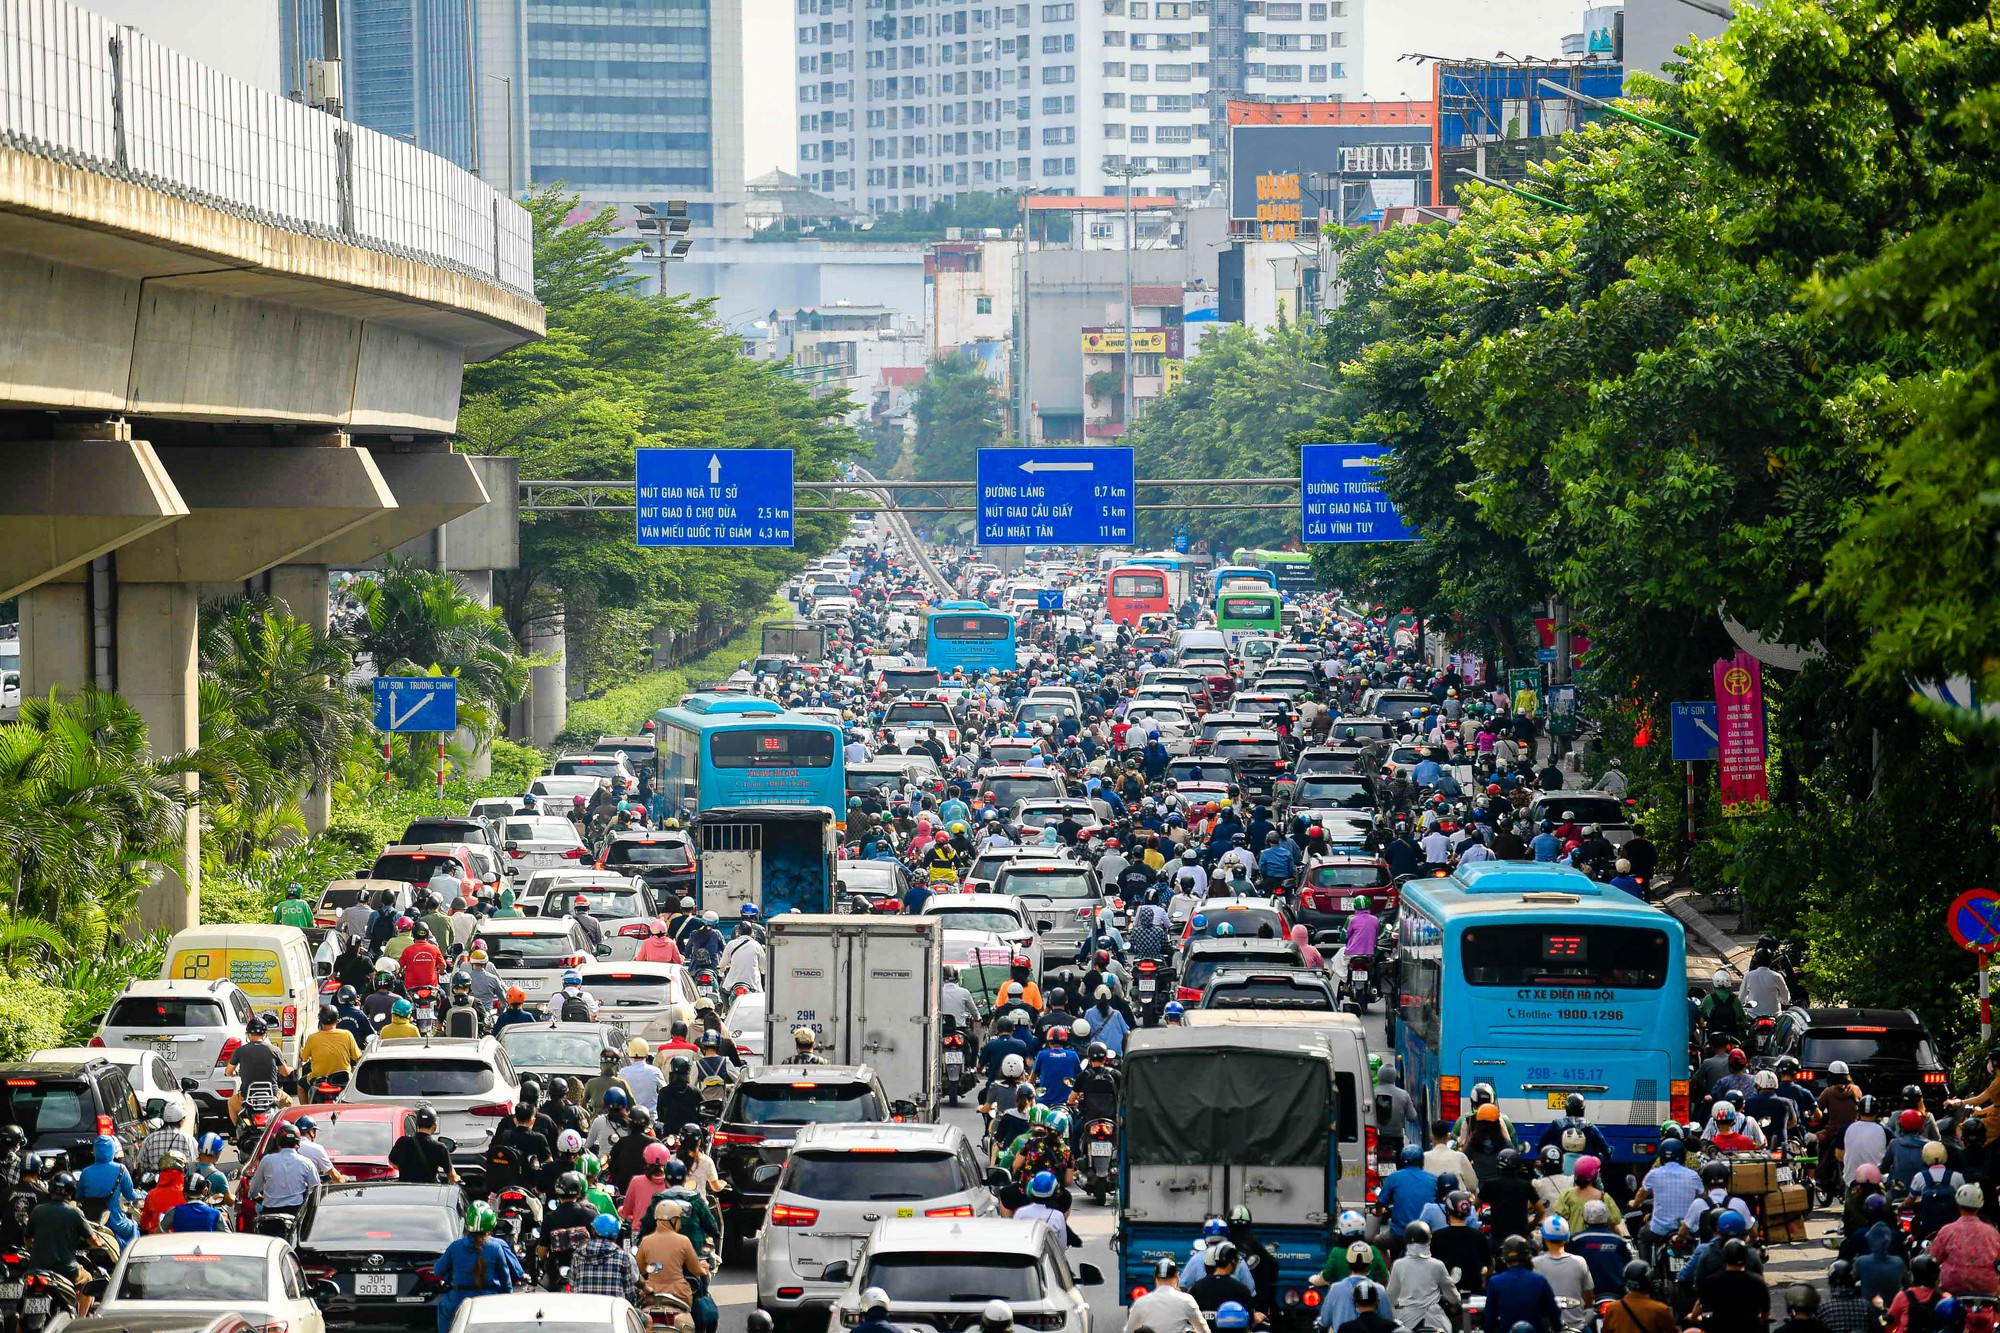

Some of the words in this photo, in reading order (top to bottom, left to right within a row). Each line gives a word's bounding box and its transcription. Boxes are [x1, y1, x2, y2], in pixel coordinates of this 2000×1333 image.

[641, 484, 658, 498] NÚT
[662, 487, 682, 498] GIAO
[686, 485, 705, 498] NGÃ
[709, 487, 721, 498] TƯ
[725, 484, 738, 498] SỞ
[985, 483, 1017, 498] ĐƯỜNG
[1021, 484, 1045, 497] LÁNG
[1111, 486, 1125, 497] km
[1307, 480, 1339, 494] ĐƯỜNG
[641, 504, 658, 518] NÚT
[662, 507, 682, 518] GIAO
[686, 505, 693, 518] Ô
[696, 506, 714, 520] CHỢ
[718, 504, 737, 518] DỪA
[775, 507, 789, 518] km
[986, 504, 1003, 518] NÚT
[1007, 506, 1028, 517] GIAO
[1031, 503, 1049, 517] CẦU
[1053, 503, 1073, 517] GIẤY
[1102, 506, 1108, 517] 5
[1111, 505, 1125, 517] km
[1308, 500, 1326, 515] NÚT
[1329, 503, 1350, 514] GIAO
[1353, 500, 1372, 513] NGÃ
[1375, 501, 1388, 513] TƯ
[641, 525, 659, 538] VĂN
[662, 524, 684, 538] MIẾU
[687, 524, 711, 539] QUỐC
[714, 523, 725, 538] TỬ
[729, 525, 751, 538] GIÁM
[775, 527, 789, 538] km
[986, 523, 1003, 537] CẦU
[1007, 524, 1031, 539] NHẬT
[1036, 524, 1053, 537] TÂN
[1100, 525, 1108, 537] 11
[1112, 525, 1126, 536] km
[1309, 520, 1327, 535] CẦU
[1330, 521, 1352, 534] VĨNH
[1356, 522, 1374, 533] TUY
[378, 680, 389, 690] TÂY
[410, 680, 434, 690] TRƯỜNG
[435, 681, 453, 690] CHINH
[1678, 706, 1689, 715] TÂY
[282, 905, 303, 915] Grab
[1517, 989, 1530, 999] CT
[1534, 989, 1547, 999] XE
[797, 1010, 815, 1020] 29H
[1517, 1009, 1552, 1019] Hotline
[1557, 1009, 1623, 1021] 1900.1296
[157, 1043, 171, 1051] 30E
[1563, 1068, 1604, 1081] 415.17
[368, 1275, 386, 1284] 30H
[360, 1284, 393, 1294] 903.33
